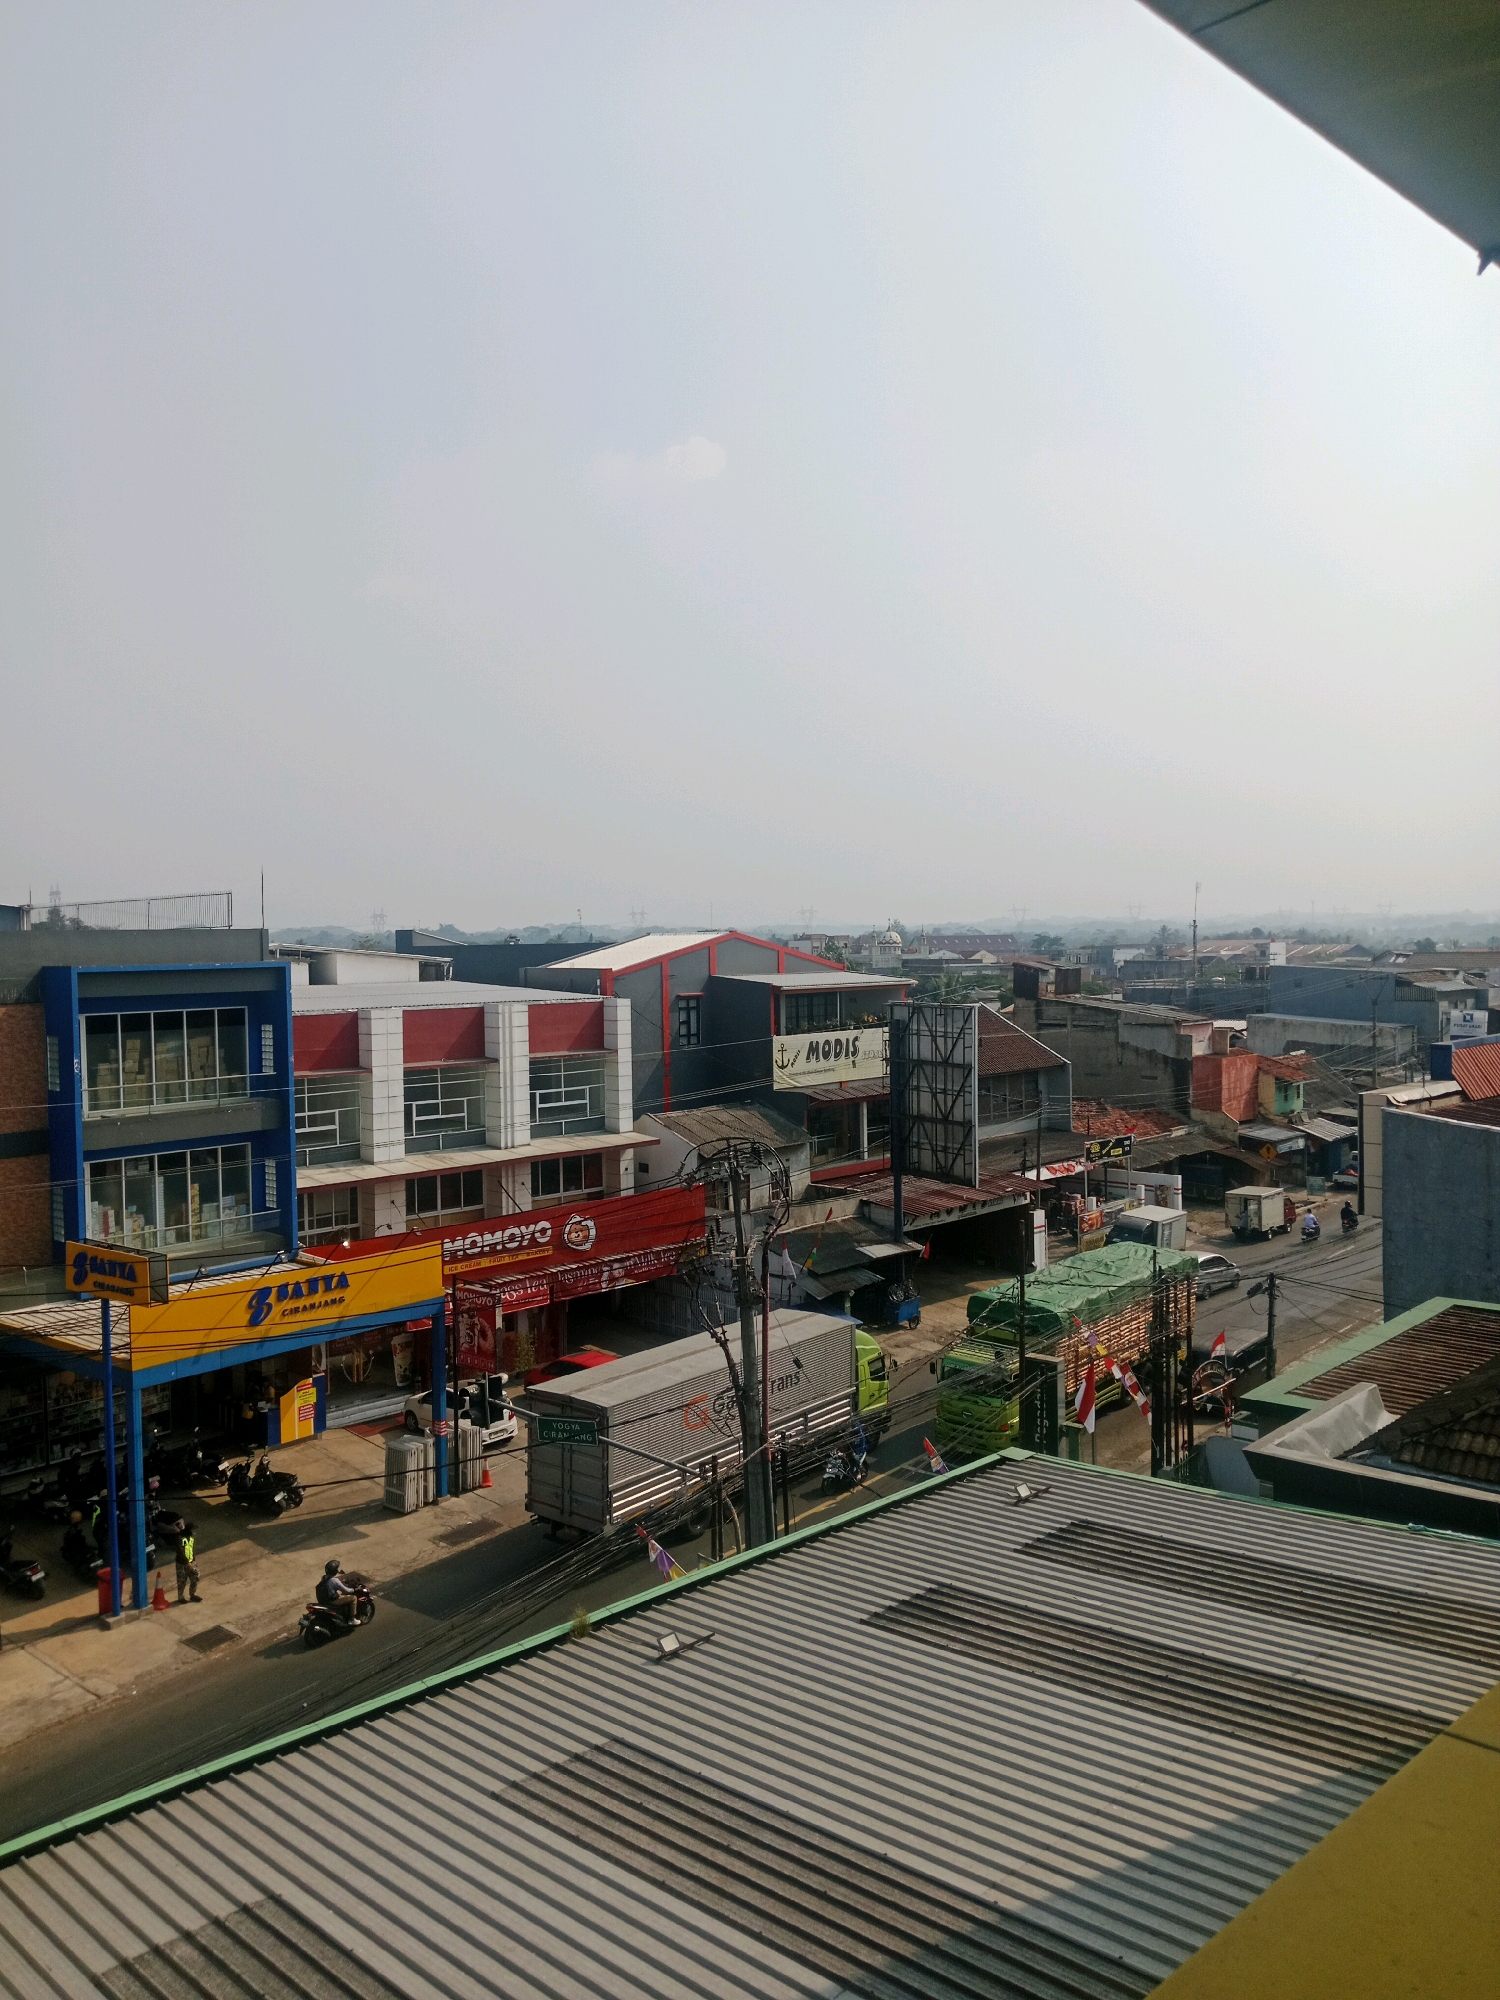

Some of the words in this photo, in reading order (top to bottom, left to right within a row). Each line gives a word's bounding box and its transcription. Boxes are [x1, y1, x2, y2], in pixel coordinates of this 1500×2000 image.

[805, 1035, 860, 1064] MODIS
[443, 1220, 552, 1260] MOMOYO
[460, 1261, 482, 1270] CREAM
[489, 1256, 506, 1265] FRUIT
[277, 1271, 351, 1302] SANYA
[281, 1296, 346, 1317] CIRANJANG
[552, 1422, 580, 1430] YOGYA
